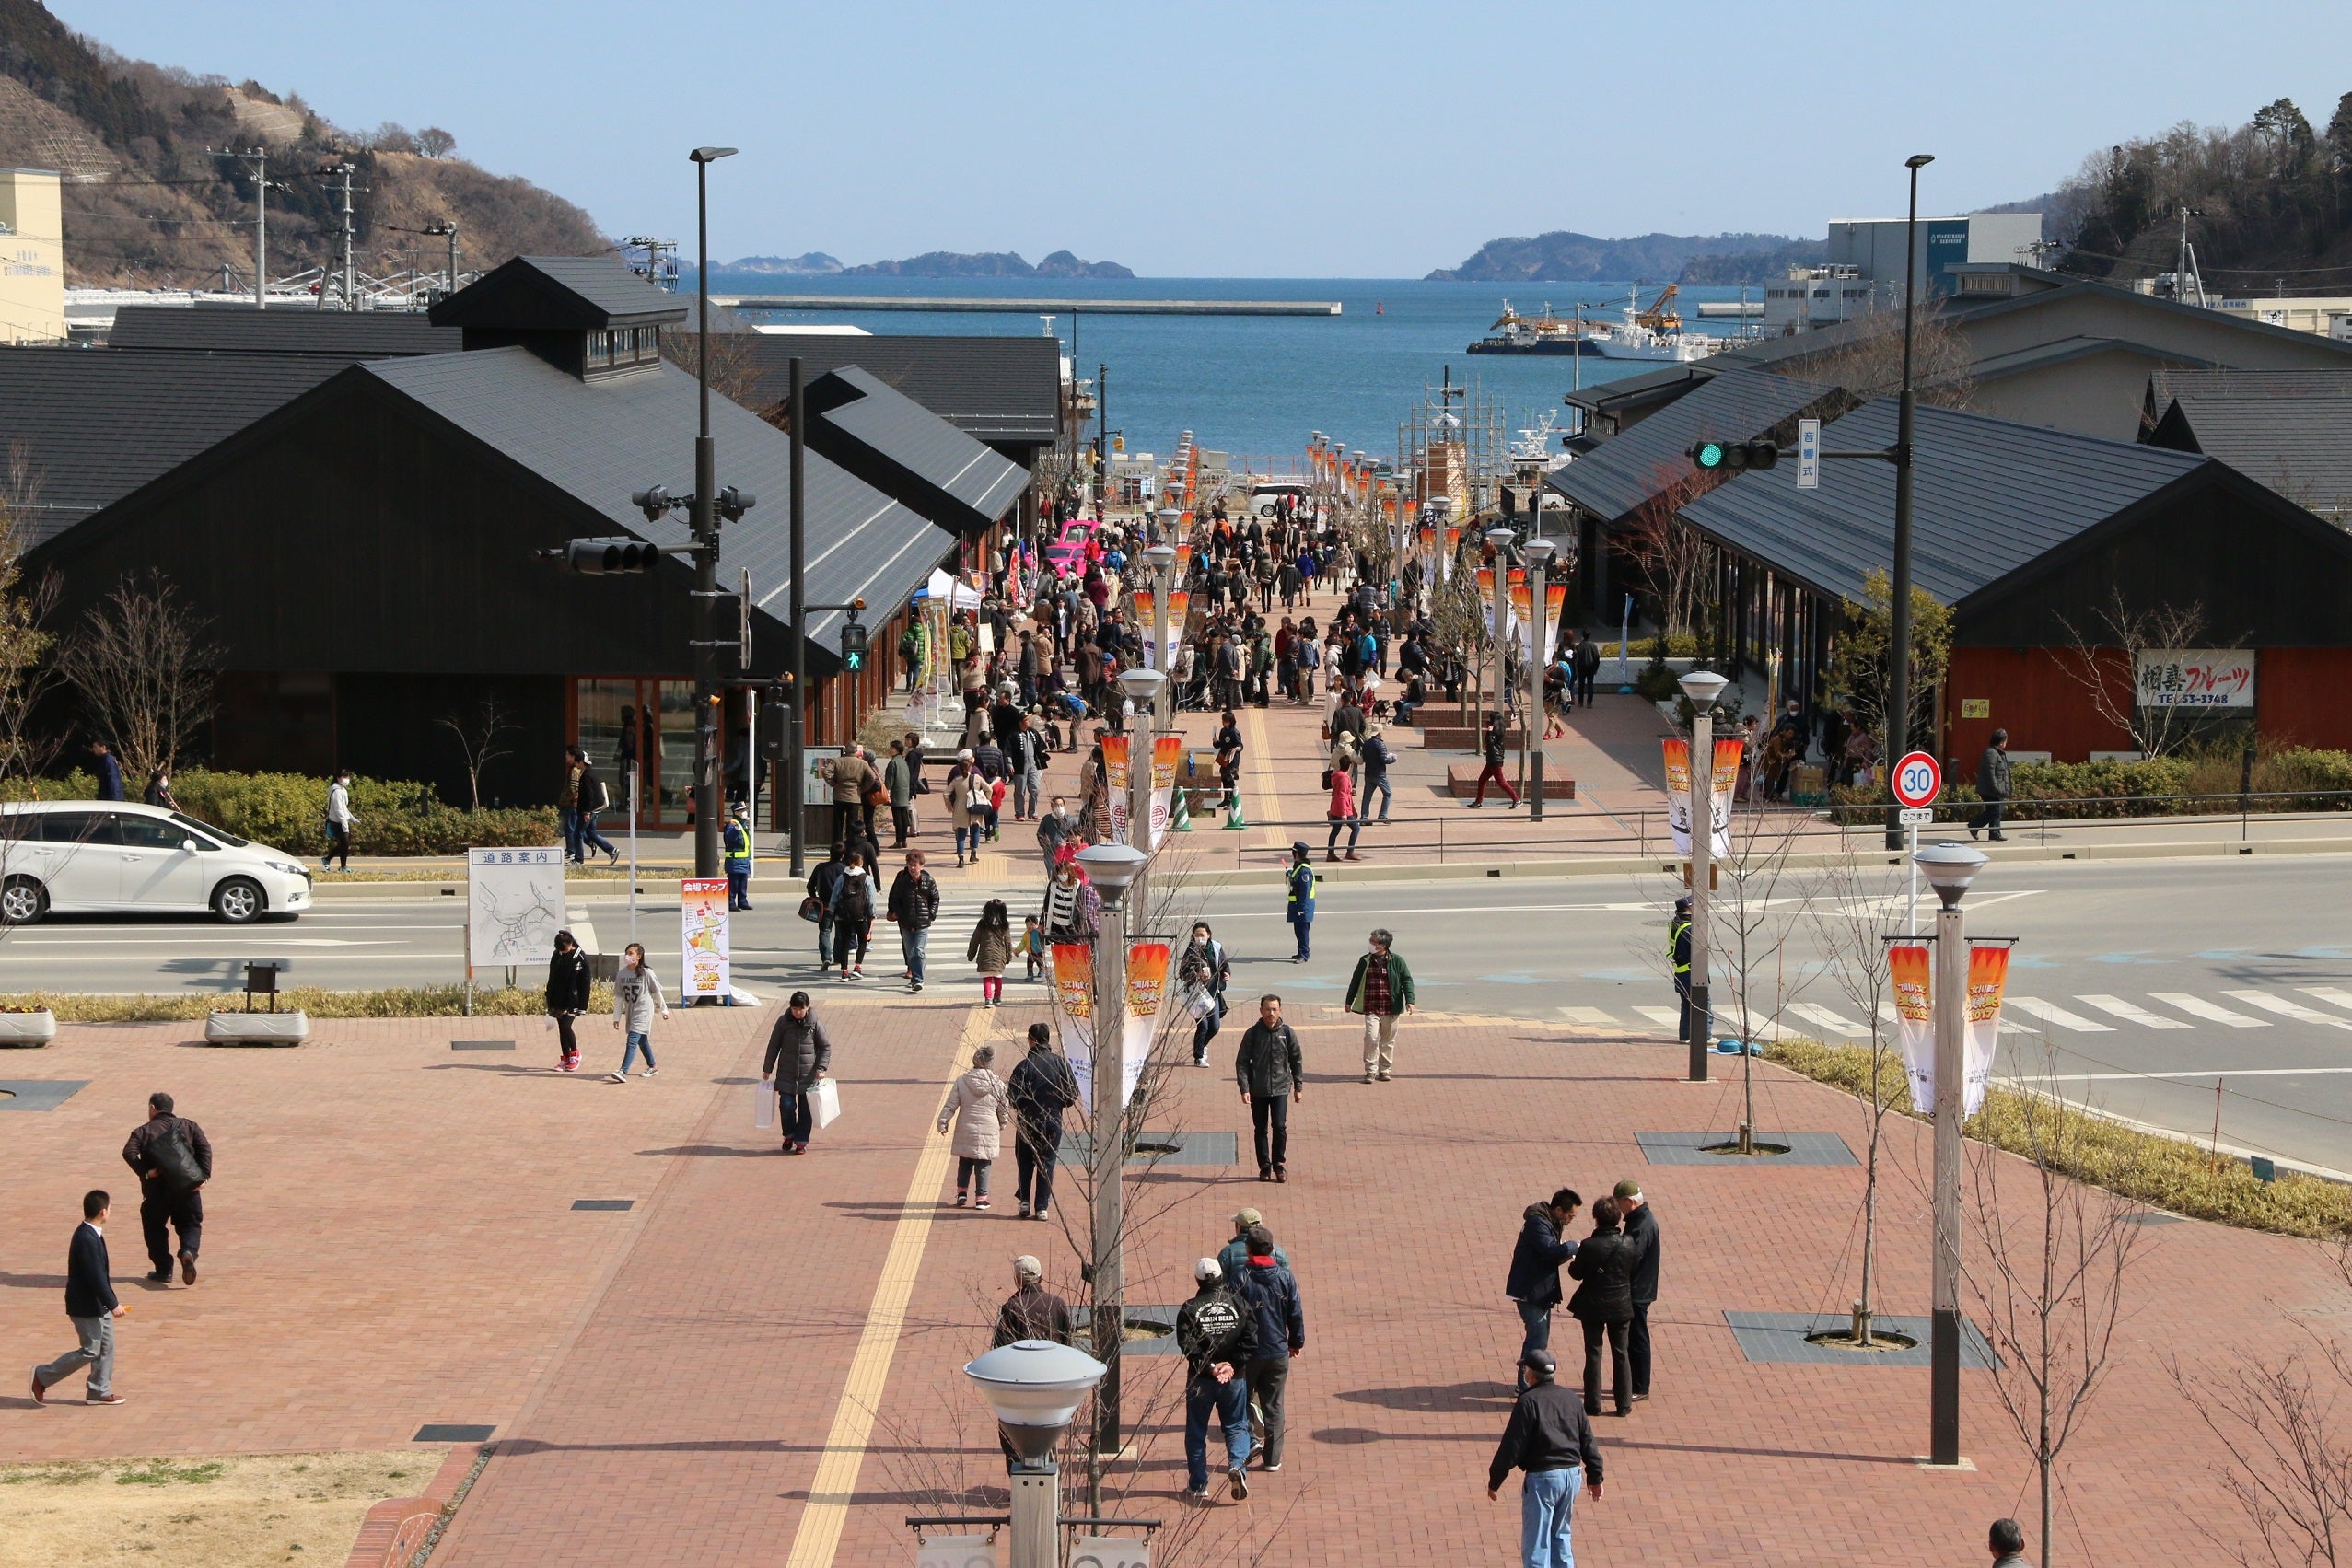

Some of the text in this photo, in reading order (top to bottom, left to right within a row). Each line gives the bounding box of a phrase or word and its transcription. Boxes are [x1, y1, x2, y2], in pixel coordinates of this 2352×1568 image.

[1802, 431, 1815, 477] 音響式
[1904, 768, 1930, 792] 30
[1902, 812, 1930, 821] ここまで
[483, 852, 548, 864] 道路案内
[683, 882, 728, 892] 会場マップ
[623, 985, 639, 1003] 65
[1968, 1009, 1995, 1023] 2017
